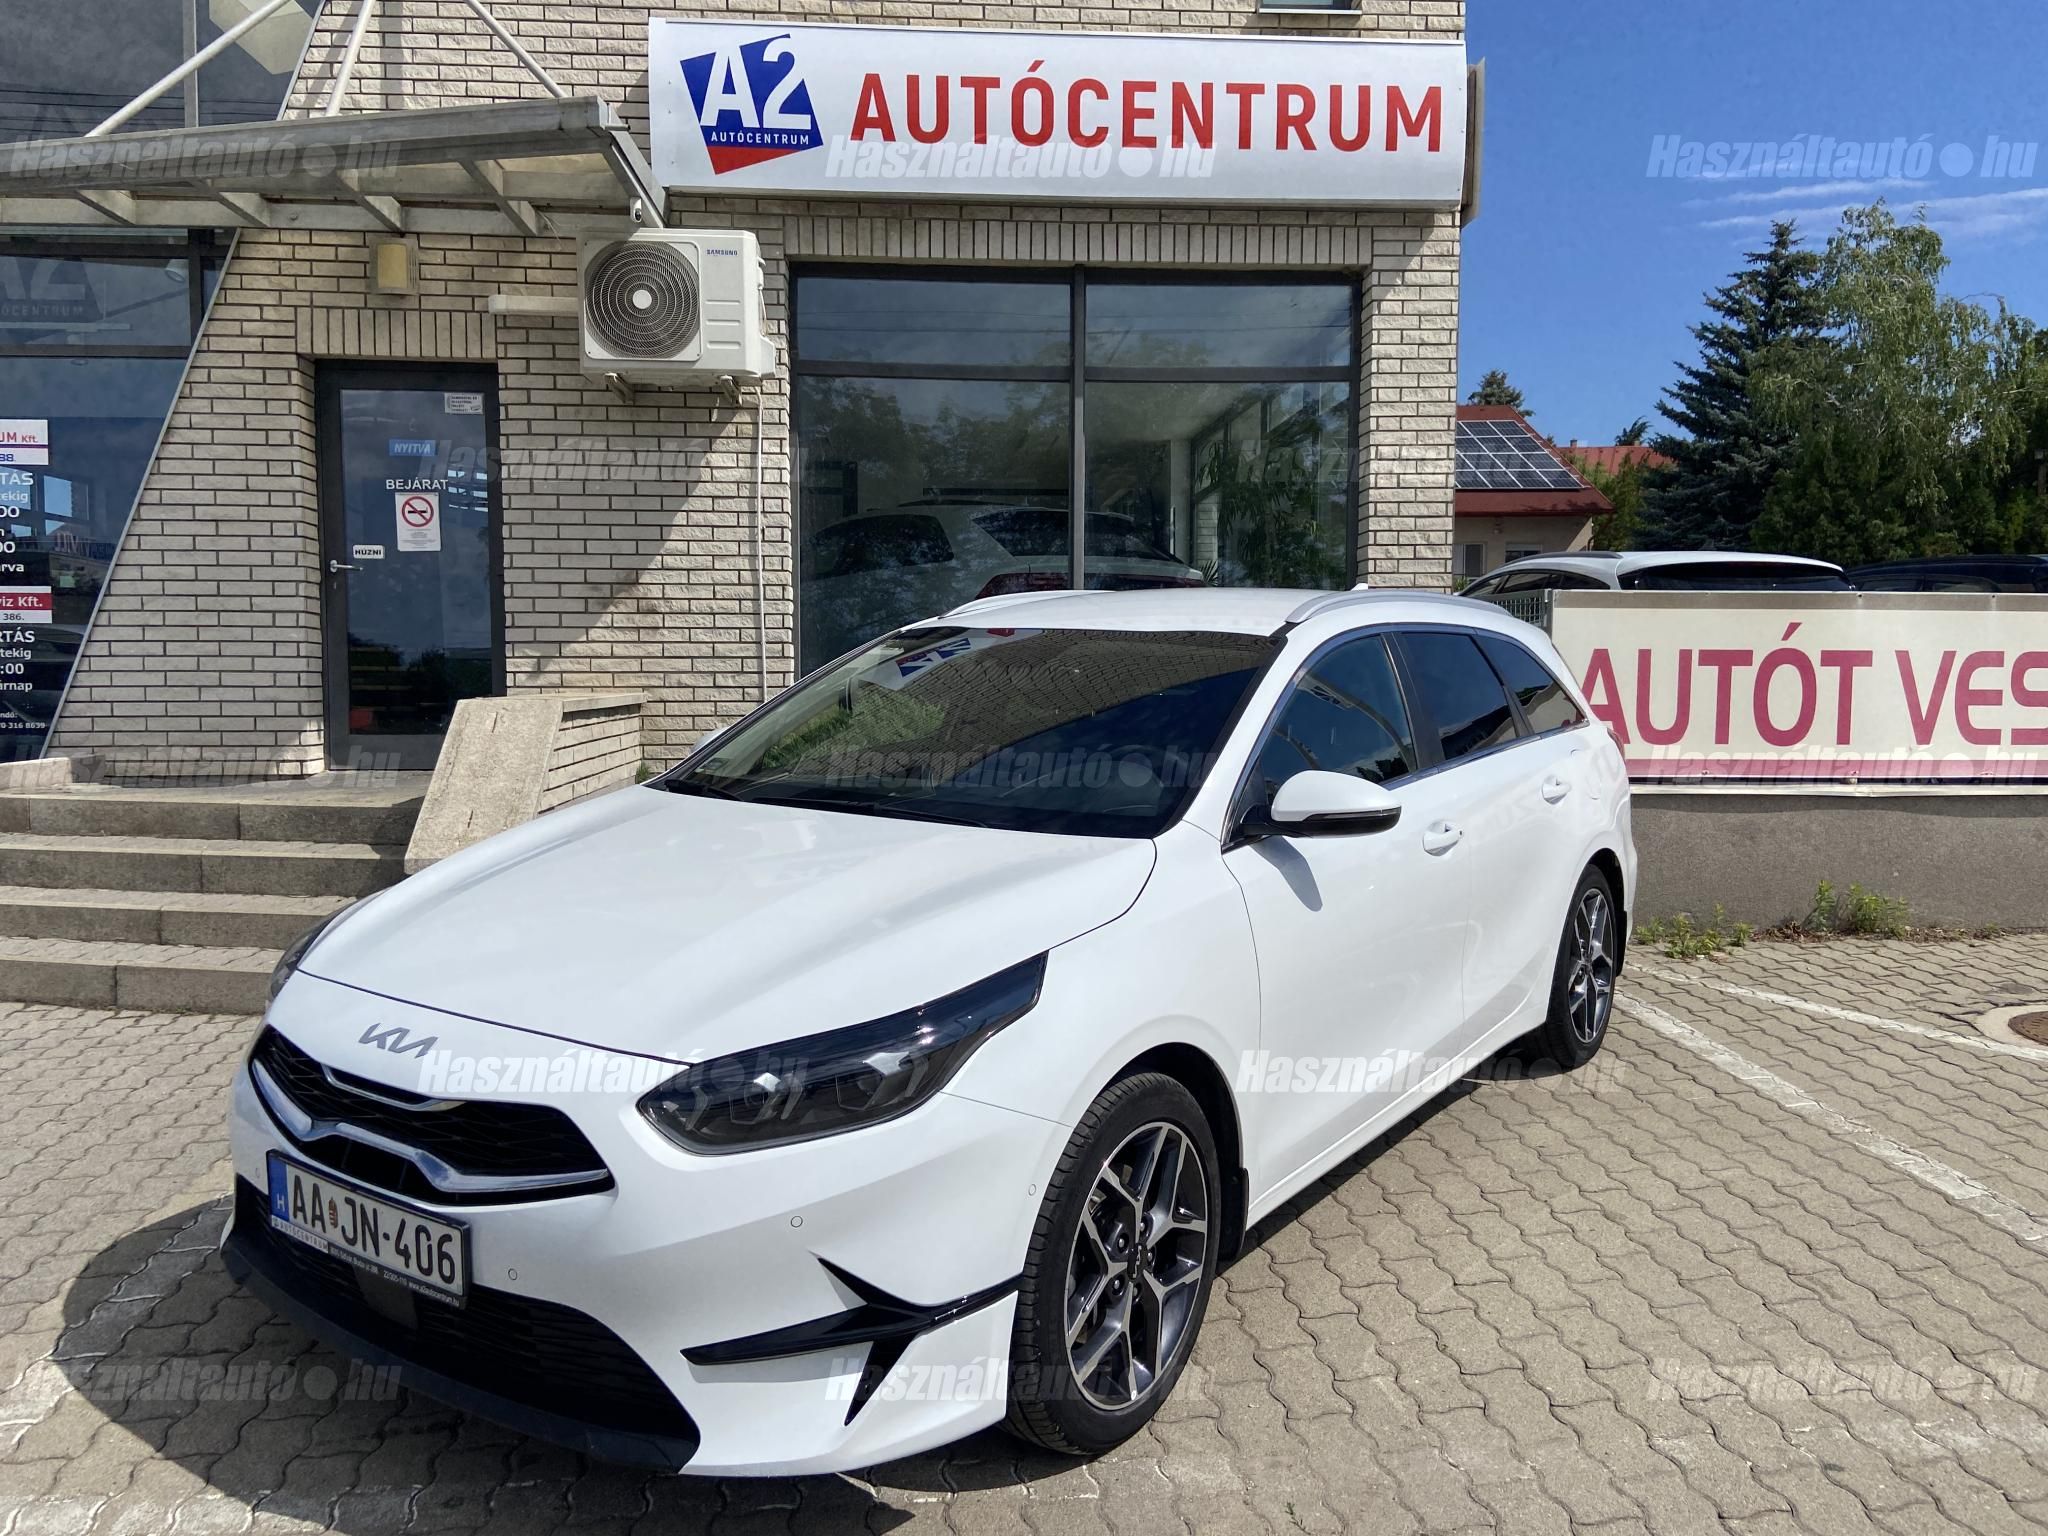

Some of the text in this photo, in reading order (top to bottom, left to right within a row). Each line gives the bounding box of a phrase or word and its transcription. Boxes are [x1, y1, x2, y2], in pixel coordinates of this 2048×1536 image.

[699, 37, 811, 130] A2
[850, 59, 1442, 153] AUTÓCENTRUM
[711, 130, 809, 145] AUTÓCENTRUM
[394, 442, 431, 454] NYITVA
[385, 477, 449, 490] BEJÁRAT
[0, 563, 24, 572] rva
[18, 596, 43, 607] Kft.
[3, 613, 25, 621] 386.
[0, 682, 33, 693] rnap
[1581, 622, 2048, 747] AUTÓT VES
[358, 1022, 439, 1059] KIA
